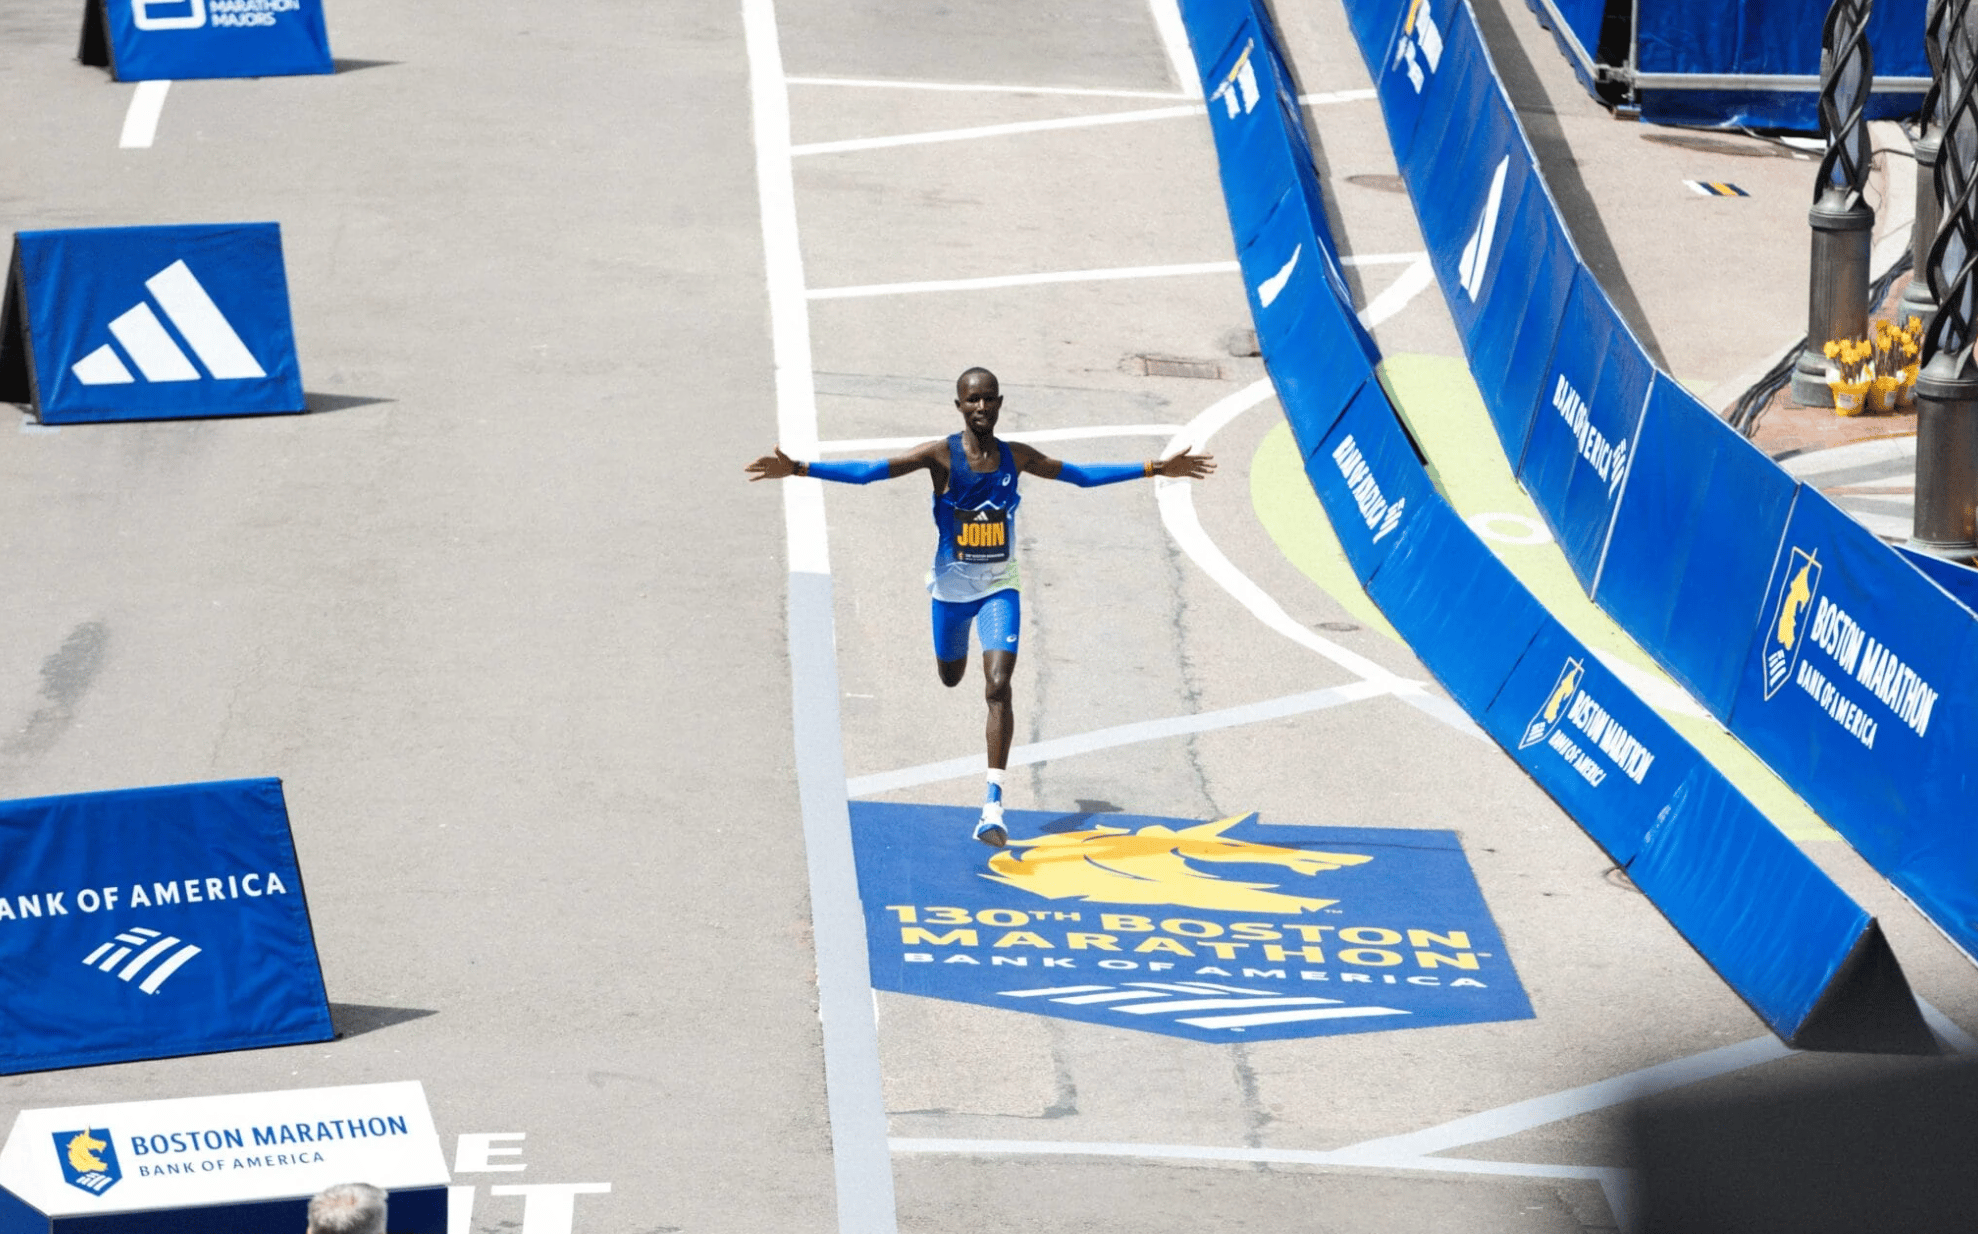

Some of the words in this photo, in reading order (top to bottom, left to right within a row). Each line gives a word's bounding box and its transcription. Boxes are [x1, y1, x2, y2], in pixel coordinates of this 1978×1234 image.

[209, 0, 300, 13] MARATHON
[211, 12, 276, 27] MAJORS
[957, 521, 1005, 547] JOHN
[1810, 595, 1865, 675] BOSTON
[1856, 637, 1937, 738] MARATHON
[1796, 659, 1826, 701] BANK
[1820, 682, 1836, 711] OF
[1829, 691, 1878, 750] AMERICA
[1567, 689, 1610, 744] BOSTON
[1598, 718, 1655, 785] MARATHON
[0, 892, 68, 921] ANK
[77, 887, 119, 913] OF
[130, 872, 287, 908] AMERICA
[885, 905, 1081, 927] 130TH
[1100, 913, 1472, 949] BOSTON
[901, 927, 1481, 970] MARATHON
[904, 953, 1076, 968] BANK
[1098, 960, 1175, 971] OF
[1195, 966, 1488, 988] AMERICA
[131, 1128, 244, 1156] BOSTON
[252, 1115, 409, 1147] MARATHON
[139, 1162, 195, 1177] BANK
[201, 1159, 225, 1172] OF
[233, 1152, 325, 1170] AMERICA
